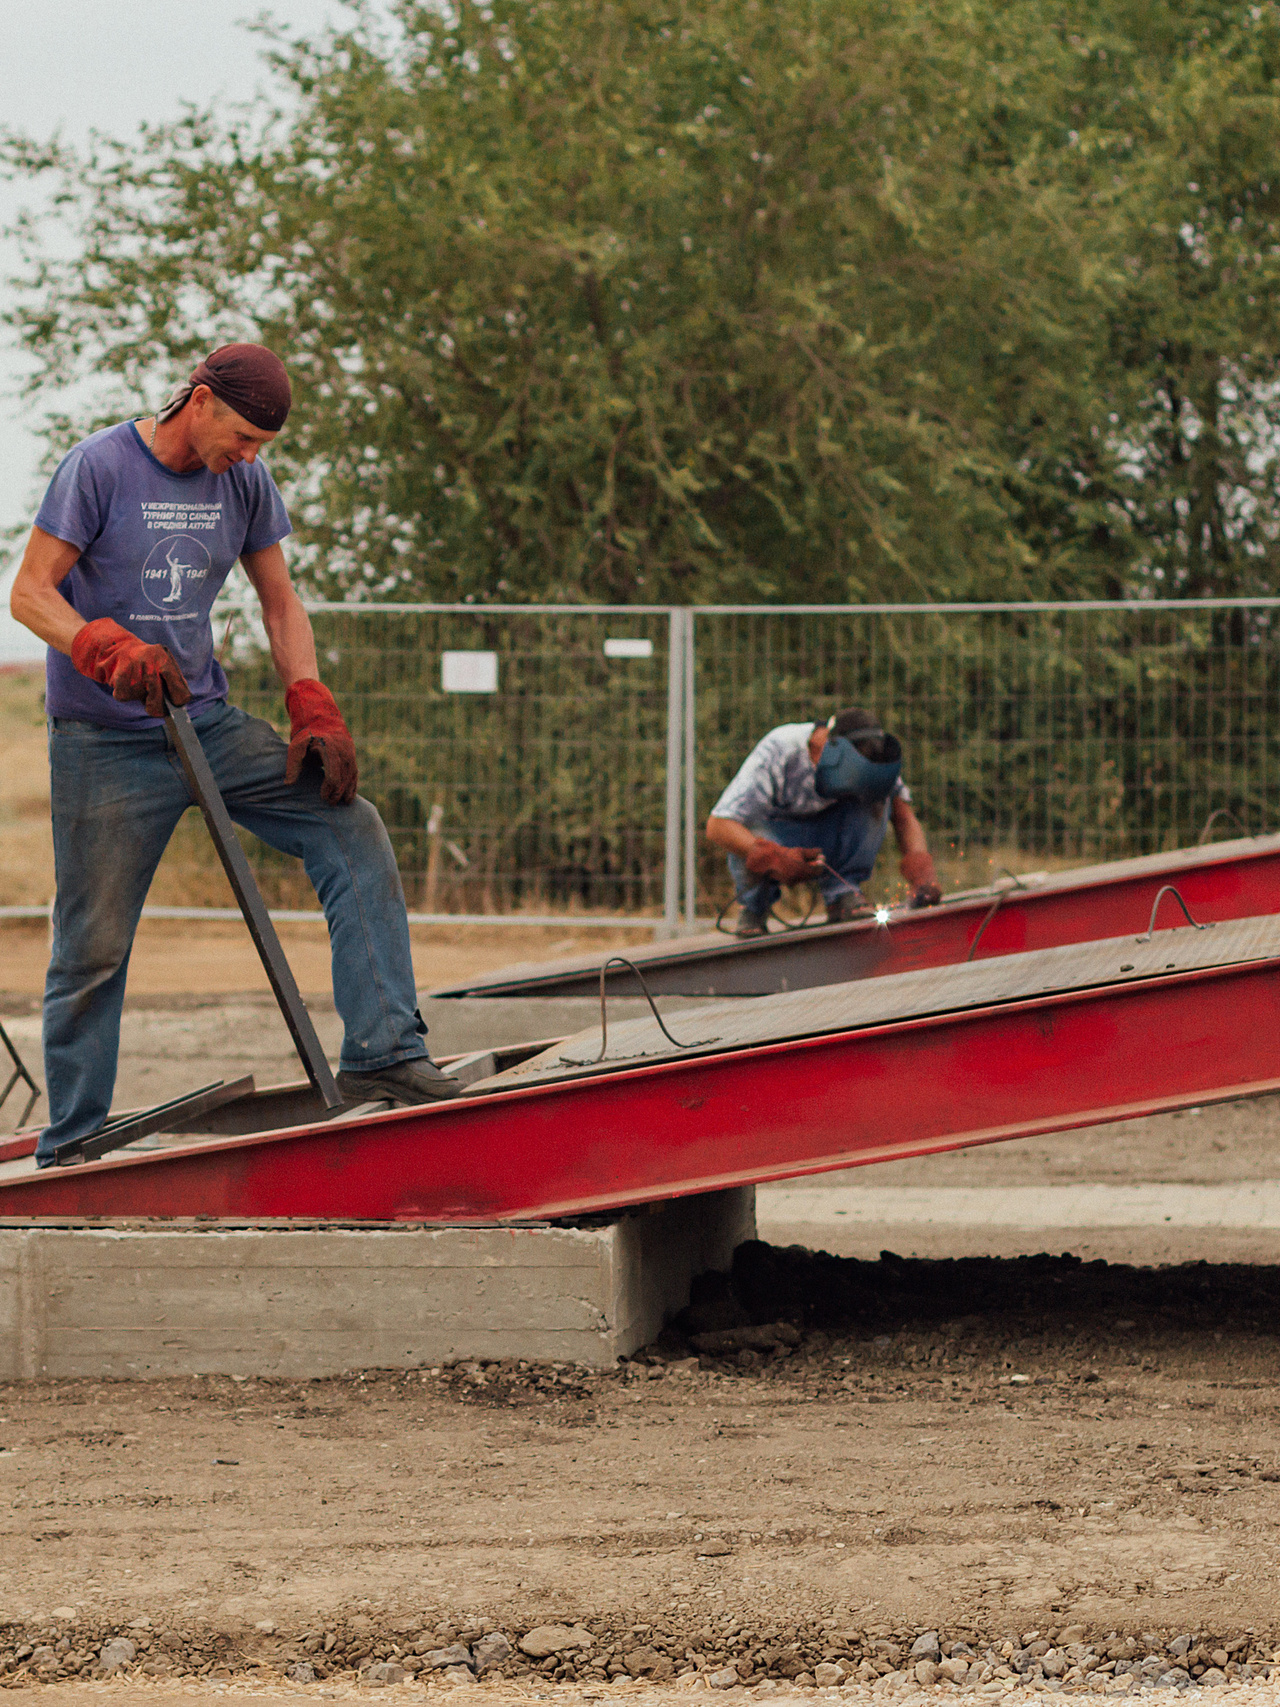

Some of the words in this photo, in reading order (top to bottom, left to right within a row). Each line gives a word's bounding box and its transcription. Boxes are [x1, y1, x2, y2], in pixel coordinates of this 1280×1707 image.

[143, 511, 175, 520] ТУРНИР
[176, 512, 188, 520] ПО
[147, 521, 153, 529] В
[154, 521, 187, 530] СРЕДНЕЙ
[145, 569, 167, 578] 1941
